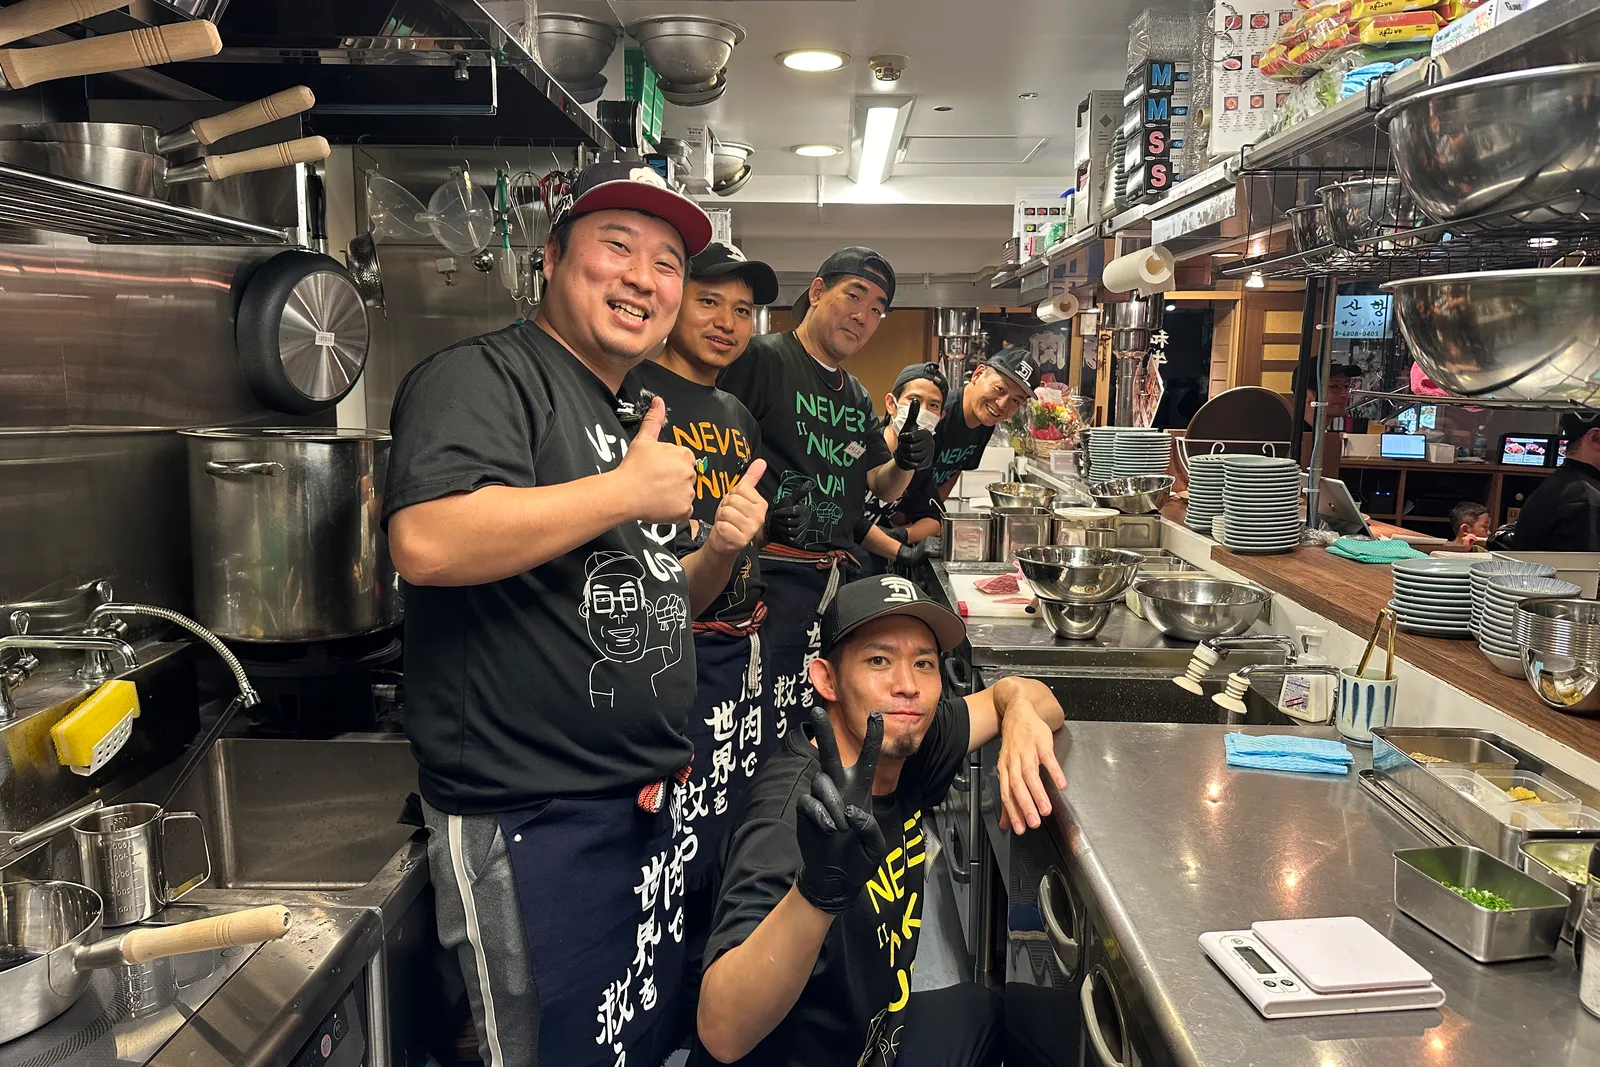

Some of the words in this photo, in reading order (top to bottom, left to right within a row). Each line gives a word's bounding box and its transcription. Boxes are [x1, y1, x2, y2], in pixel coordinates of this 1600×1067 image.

[1151, 64, 1172, 86] M
[1147, 97, 1168, 120] M
[1148, 131, 1165, 154] S
[1150, 164, 1167, 187] S
[796, 390, 866, 433] NEVER
[774, 674, 797, 739] 救う
[703, 699, 738, 816] 世界を
[633, 849, 662, 1011] 世界を
